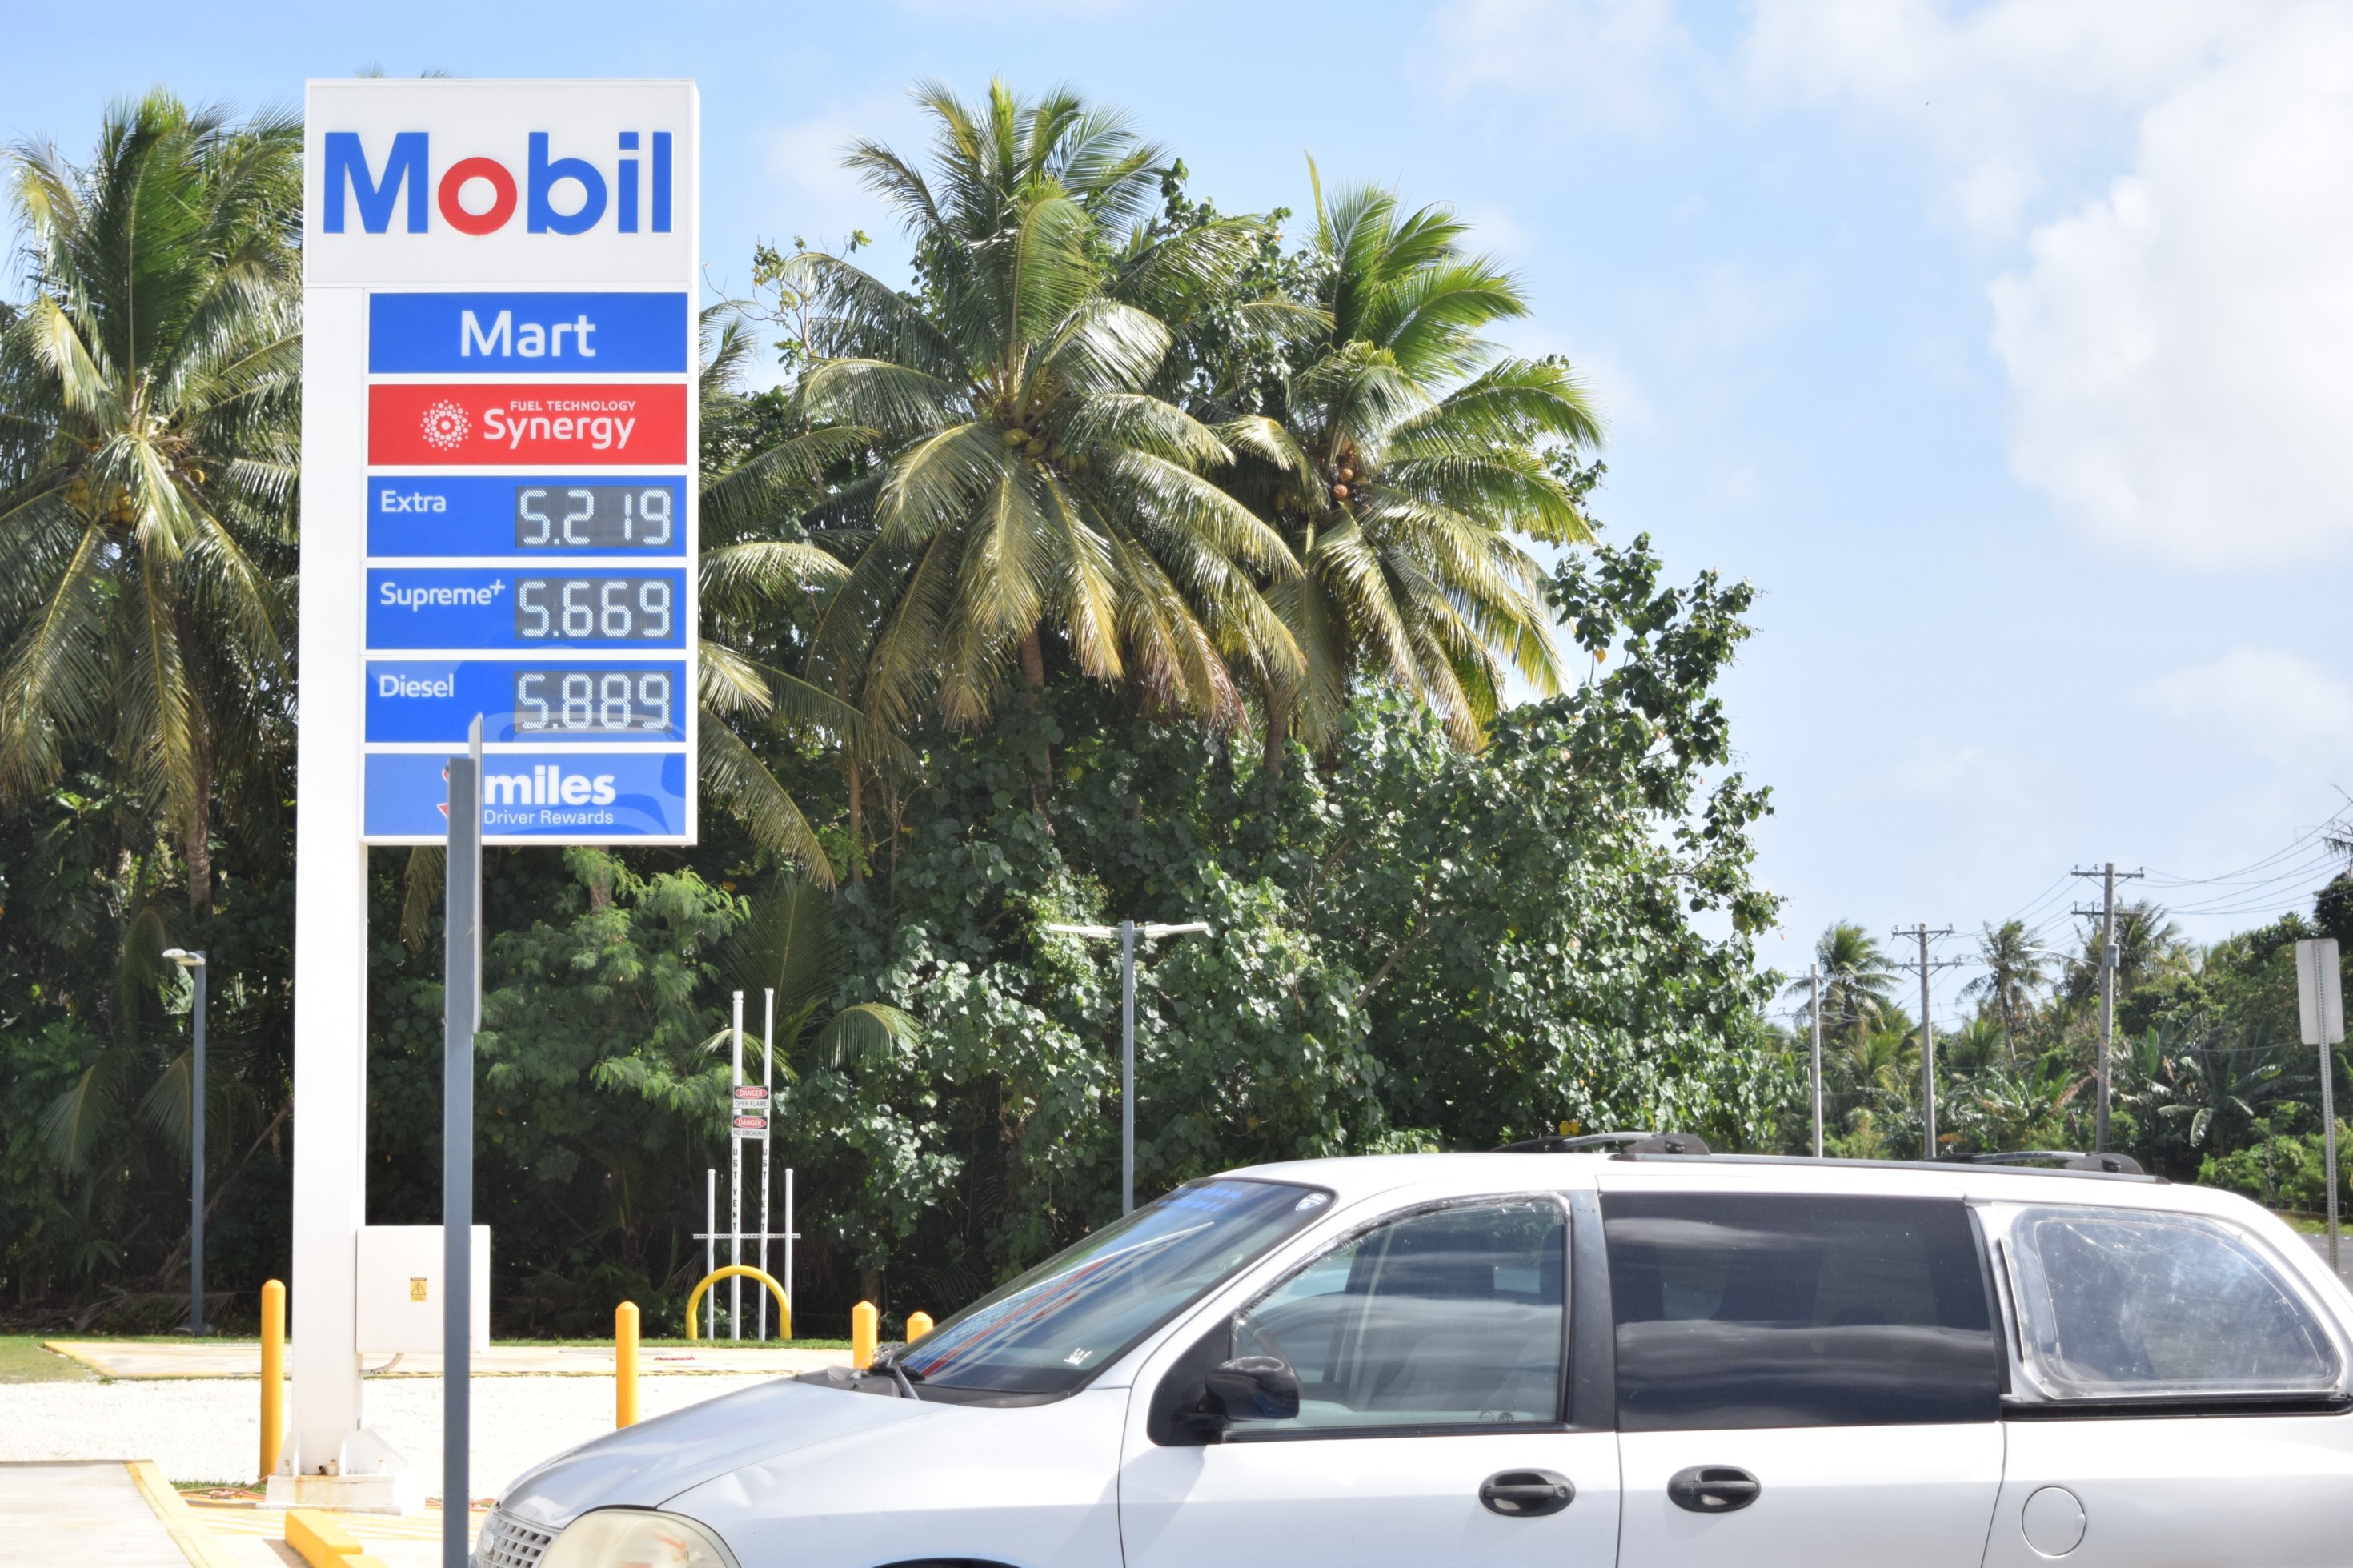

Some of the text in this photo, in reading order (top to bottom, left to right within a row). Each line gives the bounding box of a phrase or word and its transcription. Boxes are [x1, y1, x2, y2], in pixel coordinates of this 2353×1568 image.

[323, 131, 673, 236] Mobil
[460, 310, 596, 358] Mart
[510, 400, 637, 411] FUEL TECHNOLOGY
[483, 408, 636, 450] Synergy
[380, 490, 447, 513] Extra
[520, 489, 671, 545] 5.219
[519, 580, 670, 637] 5.669
[379, 673, 455, 698] Diesel
[519, 673, 669, 730] 5.889
[484, 809, 614, 824] Driver Rewards
[740, 1089, 763, 1097] DANGER
[738, 1118, 761, 1127] DANGER
